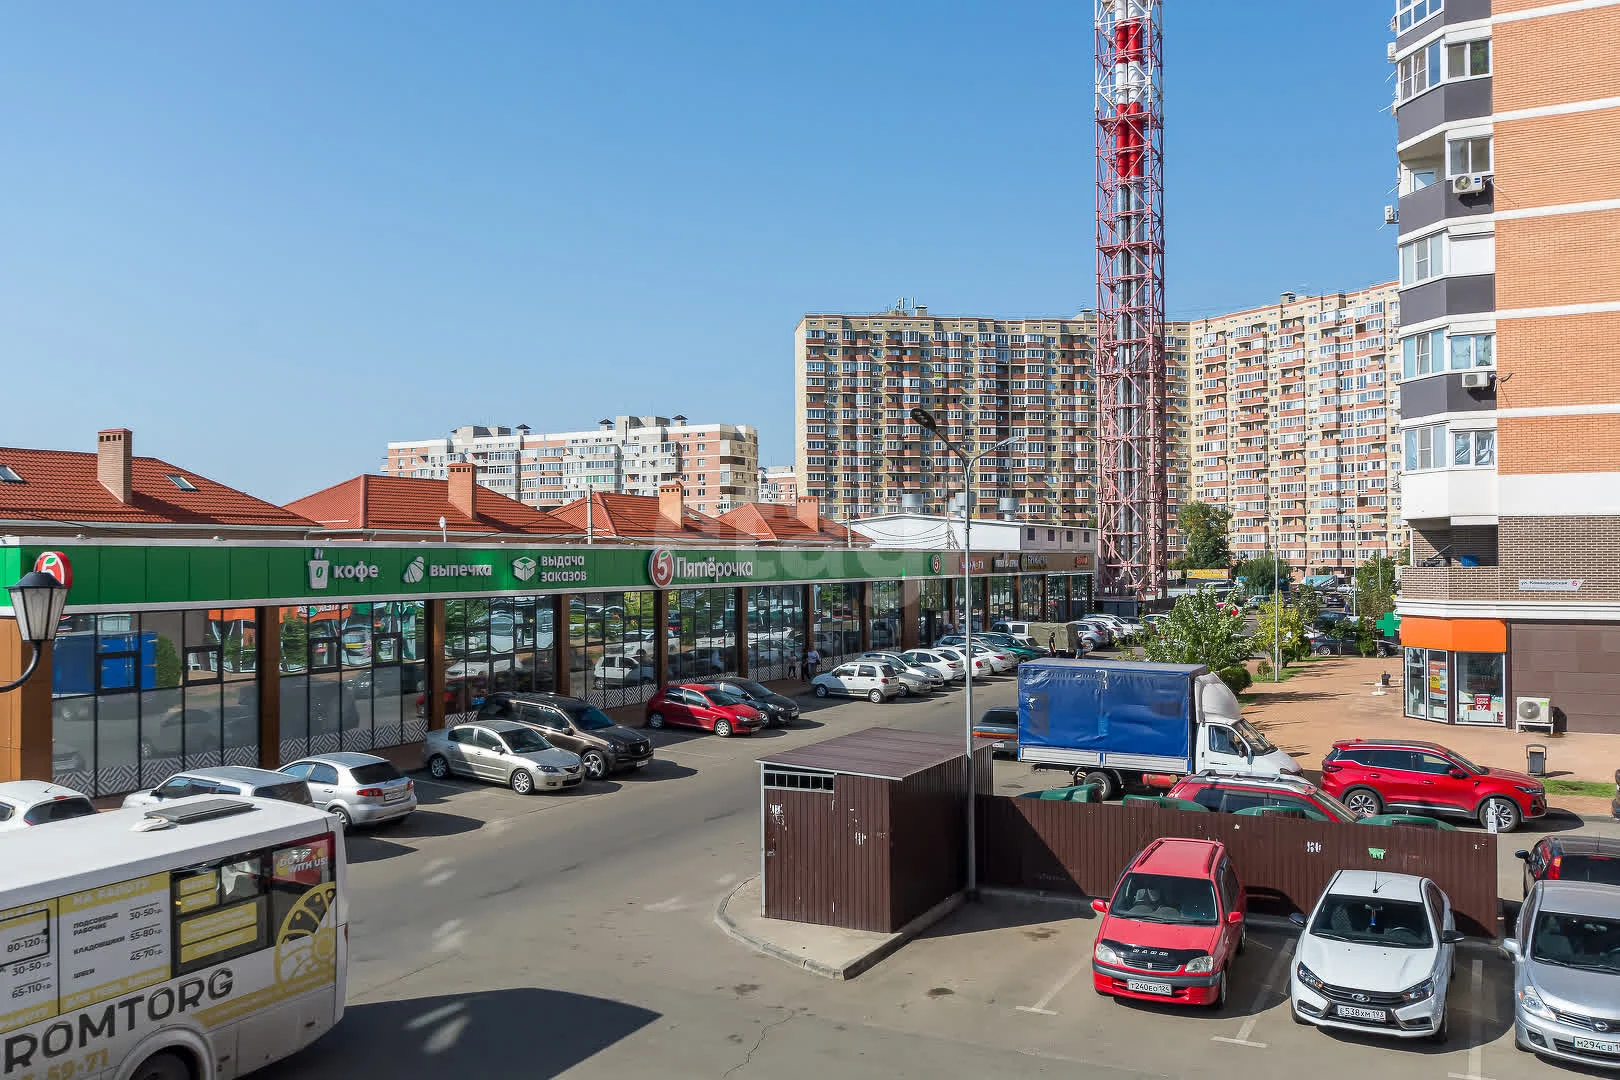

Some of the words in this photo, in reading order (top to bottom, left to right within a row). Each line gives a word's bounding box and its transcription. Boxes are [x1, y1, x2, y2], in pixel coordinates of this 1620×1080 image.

[540, 554, 585, 568] выдача
[676, 556, 753, 582] Пятёрочка
[333, 561, 378, 582] кофе
[429, 564, 493, 577] выпечка
[540, 570, 587, 583] заказов
[4, 967, 233, 1074] ROMTORG
